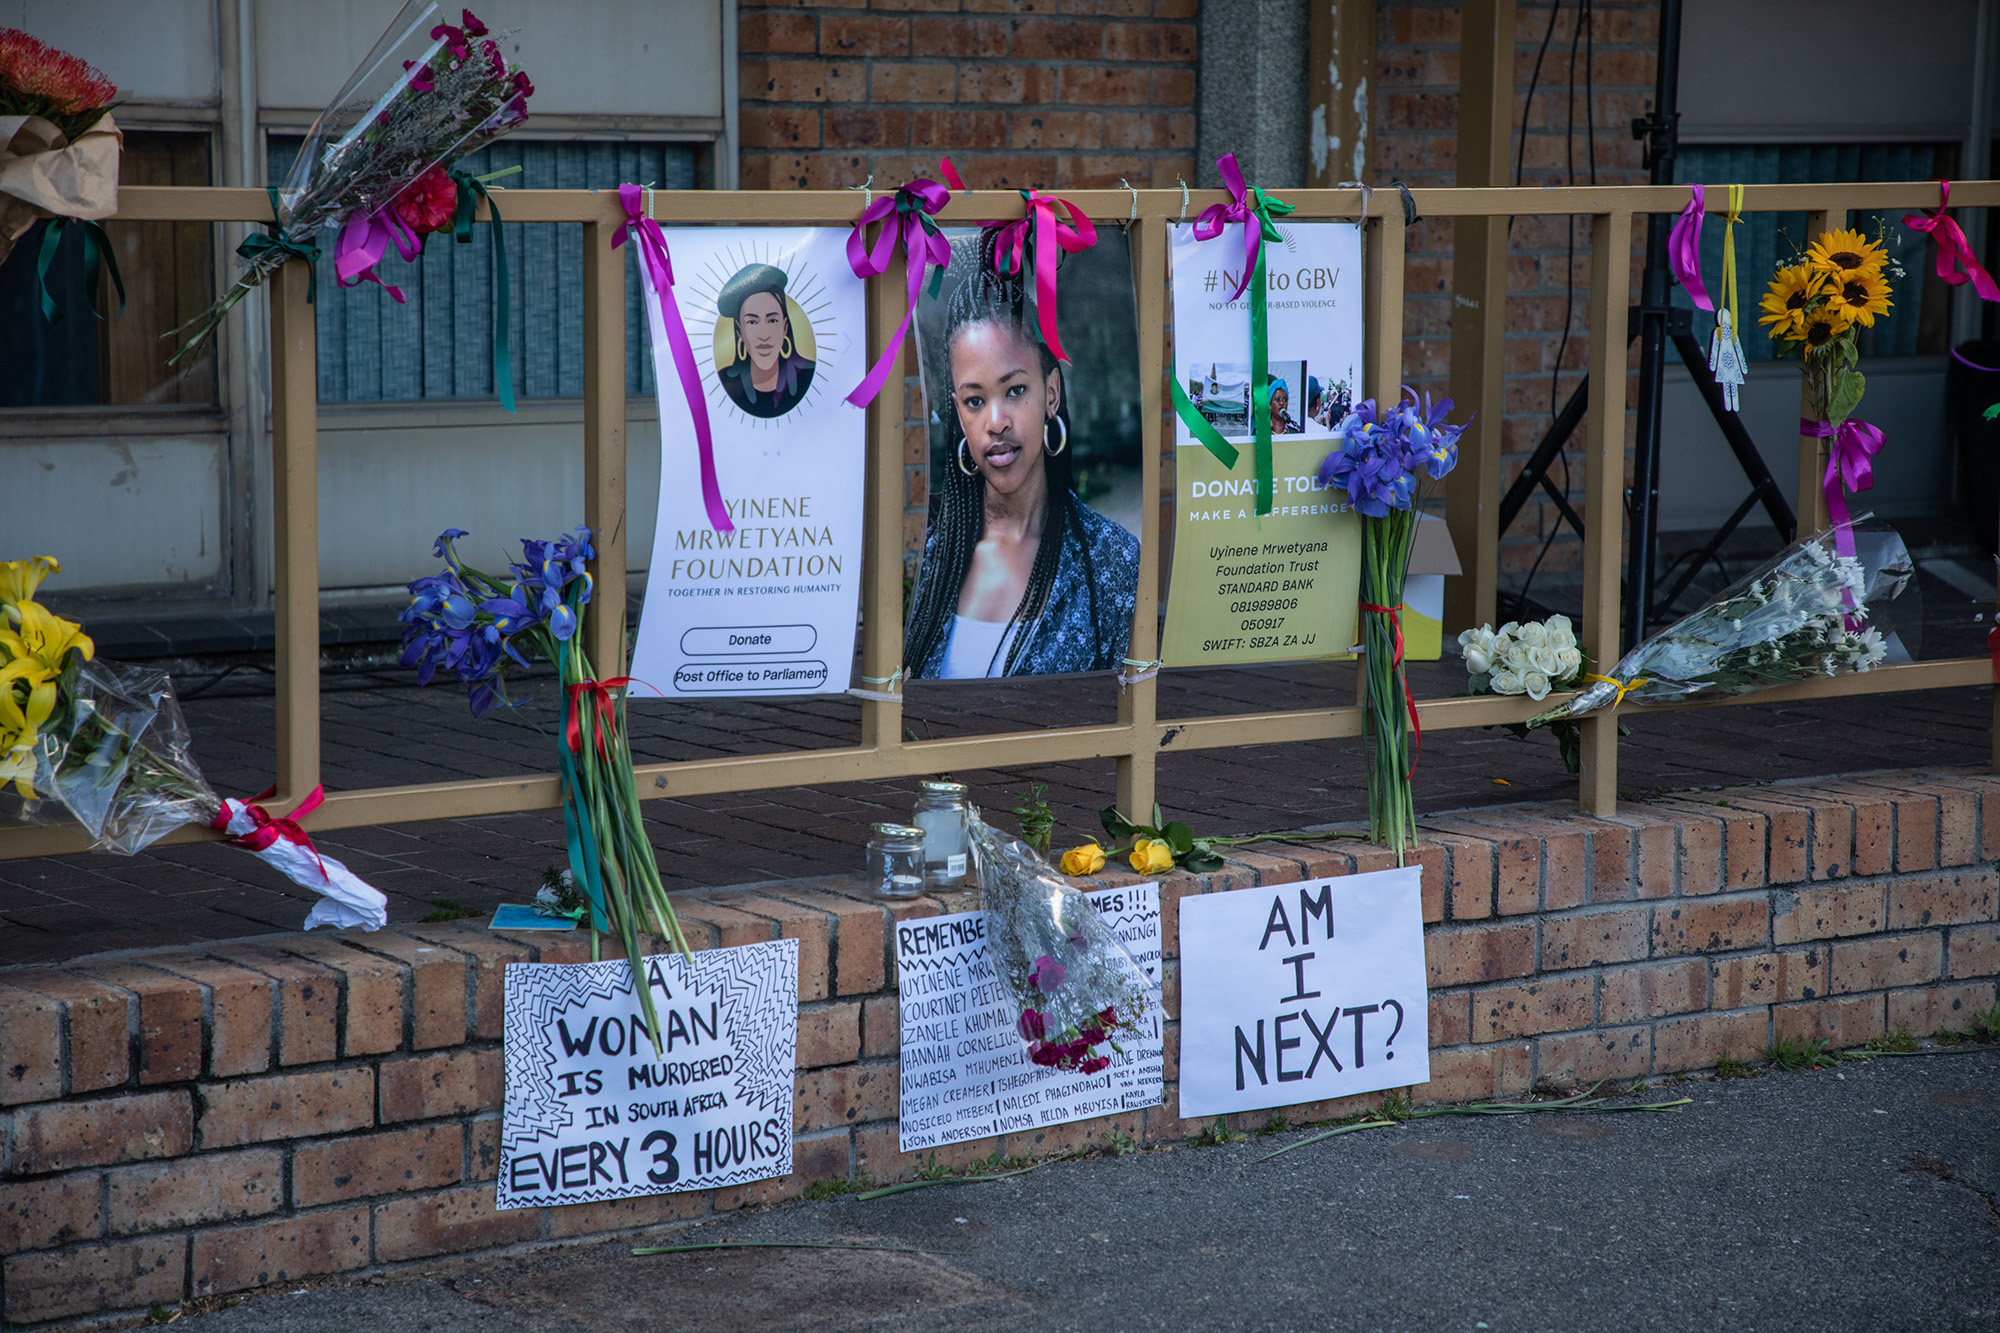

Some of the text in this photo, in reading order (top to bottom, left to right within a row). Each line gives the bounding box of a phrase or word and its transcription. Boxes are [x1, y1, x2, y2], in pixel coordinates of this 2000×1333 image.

[1268, 269, 1290, 291] to
[1296, 268, 1340, 290] GBV
[1208, 300, 1336, 310] NO TO GER-BASED VIOLENCE
[1192, 476, 1338, 498] DONATE TODA
[724, 497, 812, 519] YINENE
[1189, 503, 1348, 522] MAKE A FFERENCE
[675, 525, 834, 550] MRWETYANA
[1210, 541, 1328, 560] Uyinene Mrwetyana
[671, 554, 843, 580] FOUNDATION
[1216, 559, 1319, 577] Foundation Trust
[668, 583, 842, 598] TOGETHER IN RESTORING HUMANITY
[1218, 578, 1315, 595] STANDARD BANK
[1230, 598, 1299, 613] 081989806
[1240, 617, 1285, 631] 050917
[728, 633, 772, 646] Donate
[1202, 633, 1316, 652] SWIFT: SBZA ZA JJ
[675, 667, 828, 683] Post Office to Parliament
[898, 889, 1147, 957] REMEMBE MES!!!
[1258, 884, 1335, 951] AM
[648, 959, 673, 1000] A
[904, 967, 963, 998] UYINENE
[1280, 952, 1321, 1004] I
[903, 981, 1003, 1024] COURTNEY PIETE
[557, 1001, 718, 1058] WOMAN
[903, 1019, 959, 1046] ZANELE
[904, 1030, 1019, 1071] HANNAH CORNELIUS
[1234, 998, 1404, 1091] NEXT?
[1106, 1050, 1134, 1070] NINE
[558, 1055, 734, 1098] IS MURDERED
[905, 1052, 1020, 1094] NWABISA MTHUMENI
[1113, 1069, 1129, 1079] JOEY
[1120, 1080, 1133, 1088] VAN
[905, 1093, 939, 1115] MEGAN
[943, 1083, 990, 1104] CREAMER
[997, 1066, 1057, 1092] TSHEGOFATSO
[1003, 1091, 1042, 1112] NALEDI
[1125, 1090, 1145, 1099] KAYLA
[585, 1090, 728, 1130] IN SOUTH AFRICA
[908, 1098, 1119, 1148] JOAN ANDERSON NOMSA HILDA MBUYISA
[510, 1118, 781, 1193] EVERY 3 HOURS
